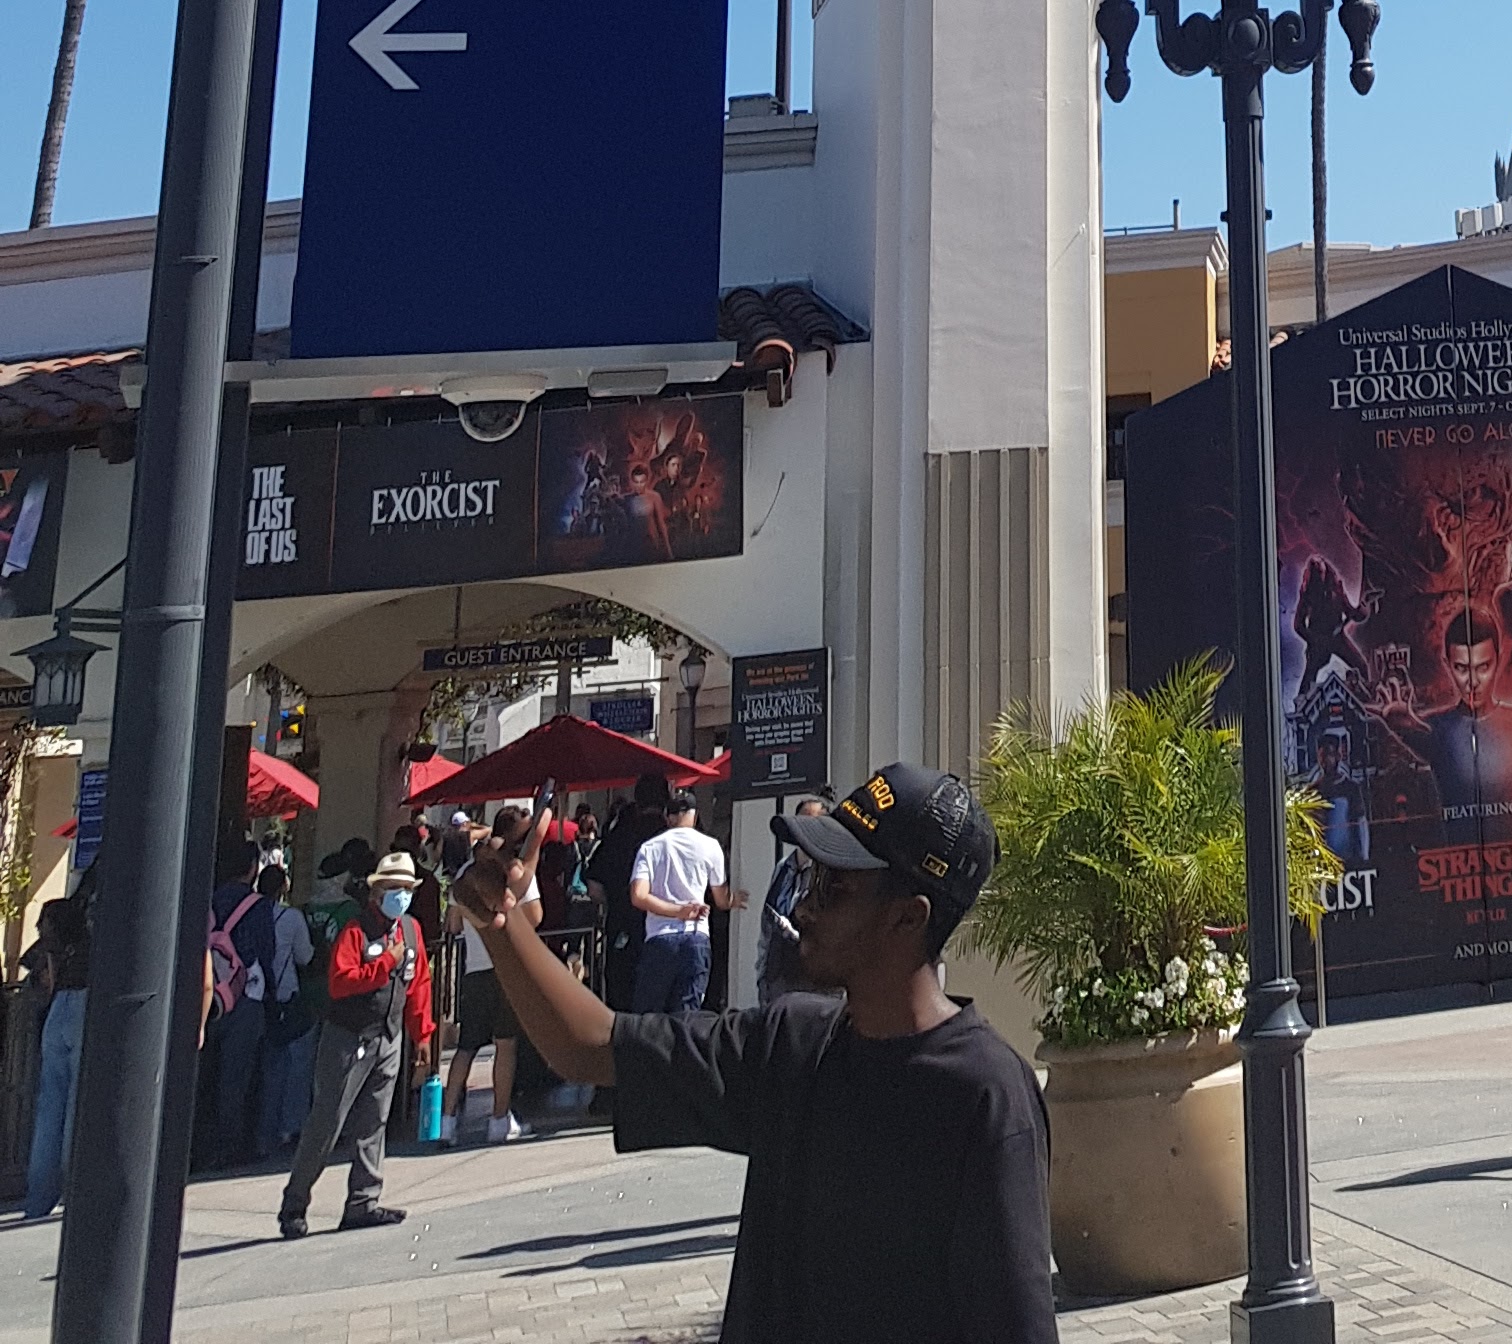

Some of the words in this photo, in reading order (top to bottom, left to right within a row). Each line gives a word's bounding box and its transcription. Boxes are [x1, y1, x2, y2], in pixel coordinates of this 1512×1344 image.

[1339, 324, 1408, 346] Universal
[1411, 322, 1467, 341] Studios
[1329, 370, 1457, 410] HORROR
[1361, 408, 1405, 422] SELECT
[1409, 404, 1454, 417] NIGHTS
[1456, 402, 1488, 415] SEPT.
[1489, 402, 1496, 412] 7
[1375, 426, 1436, 449] NEVER
[1446, 424, 1475, 444] GO
[252, 465, 286, 500] THE
[420, 469, 452, 485] THE
[248, 496, 295, 532] LAST
[370, 480, 500, 525] EXORCIST
[245, 531, 269, 565] OF
[269, 528, 298, 563] US
[444, 648, 495, 666] GUEST
[500, 642, 587, 662] ENTRANCE
[1320, 869, 1378, 912] CIST
[1454, 943, 1485, 960] AND
